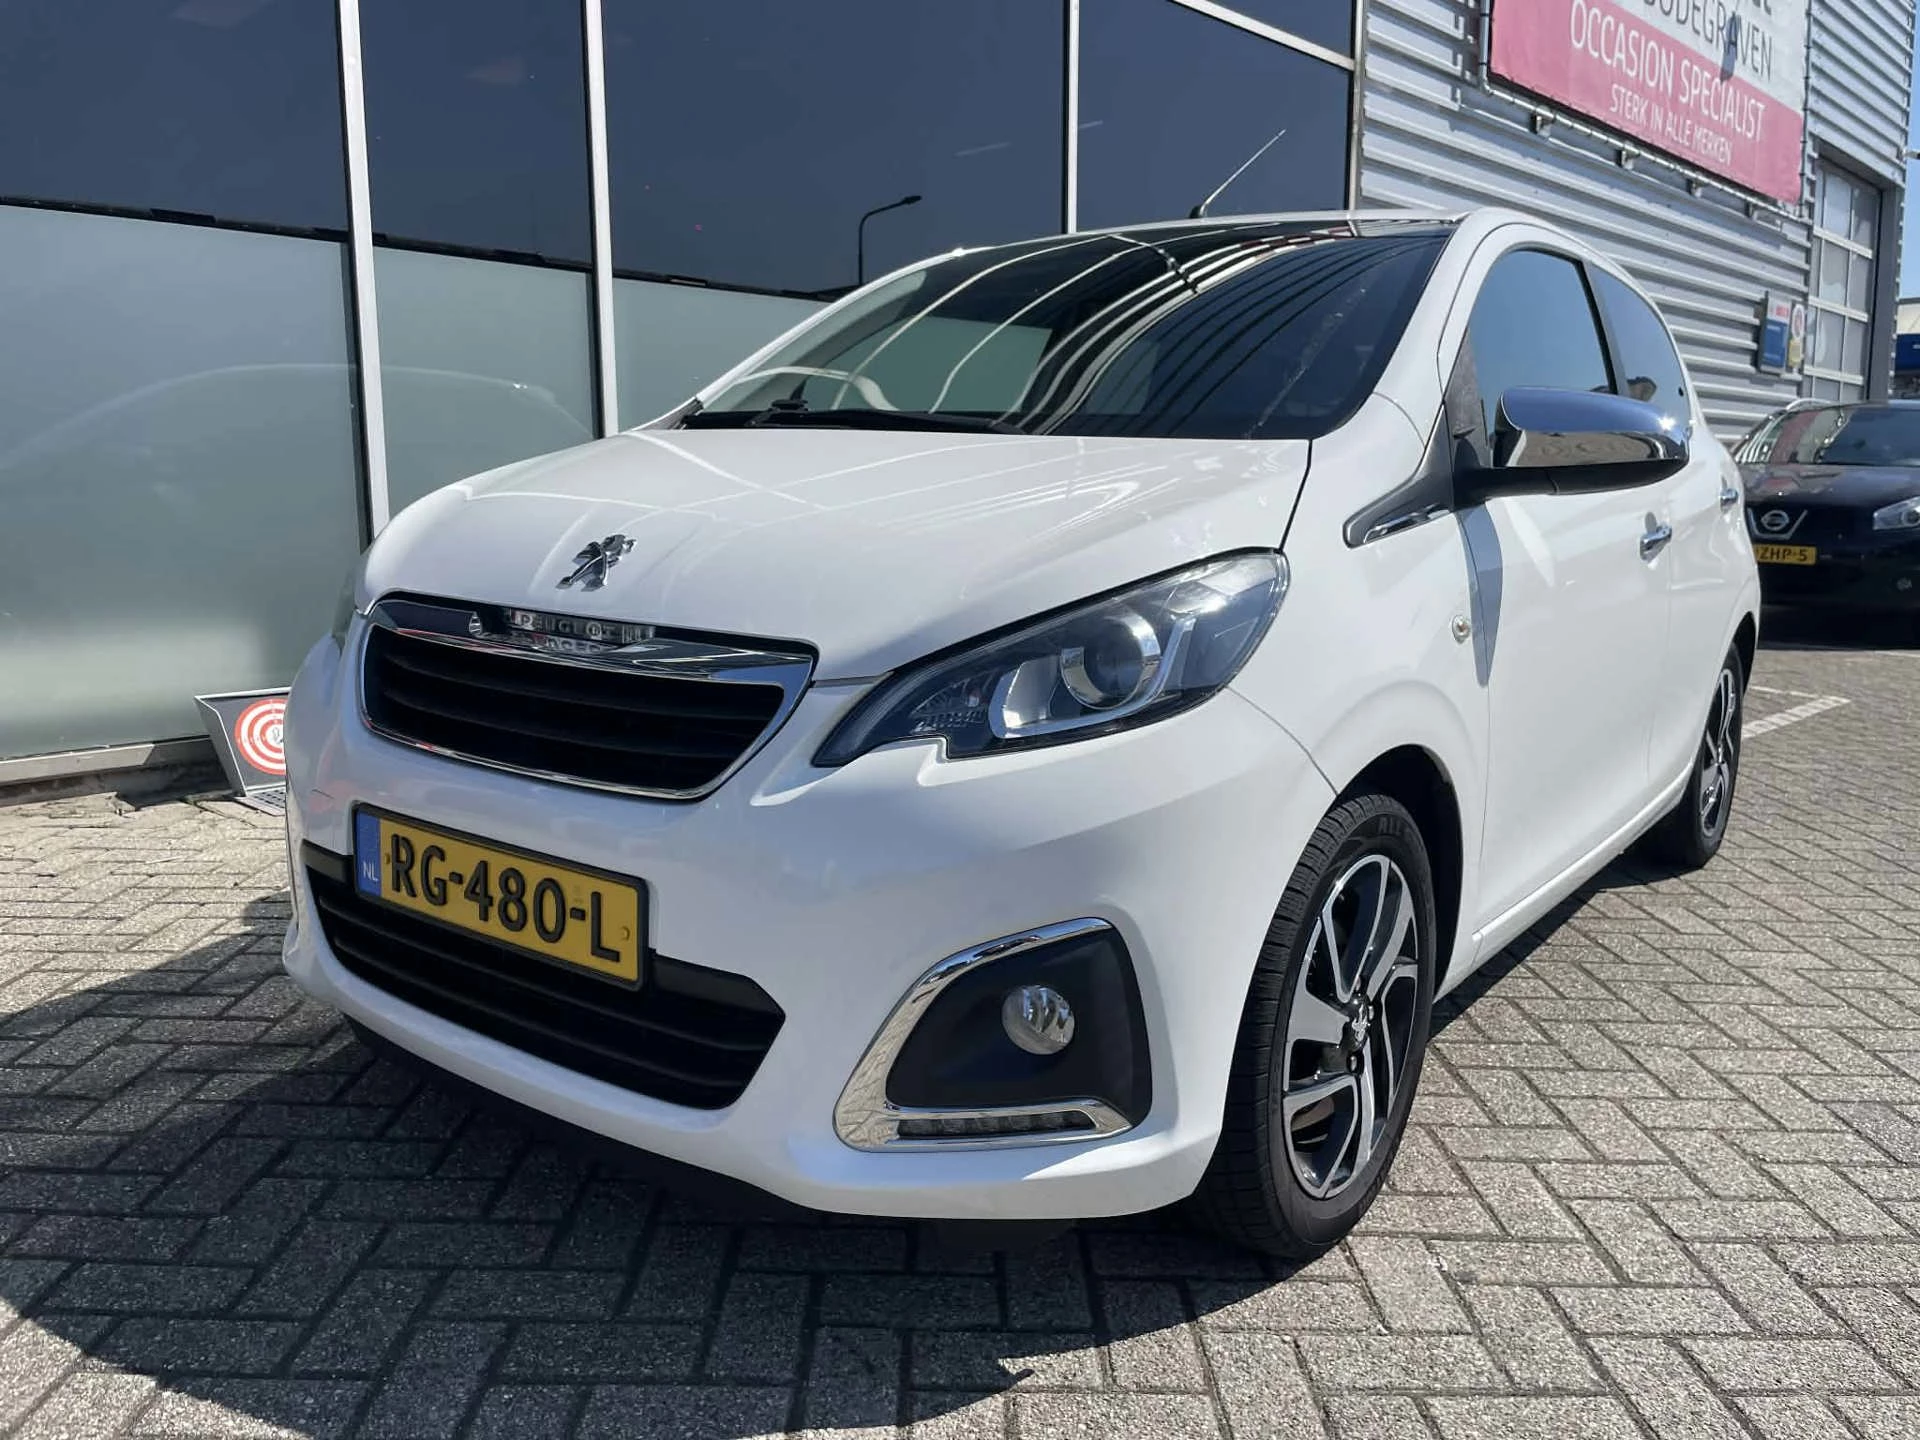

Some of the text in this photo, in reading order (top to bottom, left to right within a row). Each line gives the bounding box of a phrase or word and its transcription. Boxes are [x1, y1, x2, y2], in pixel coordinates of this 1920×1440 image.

[1571, 0, 1766, 142] OCCASION SPECIALIST
[1643, 0, 1772, 82] DEGRAVEN
[1610, 83, 1733, 166] STERK IN ALLE MERKEN
[362, 861, 379, 881] NL
[391, 833, 620, 963] RG-480-L
